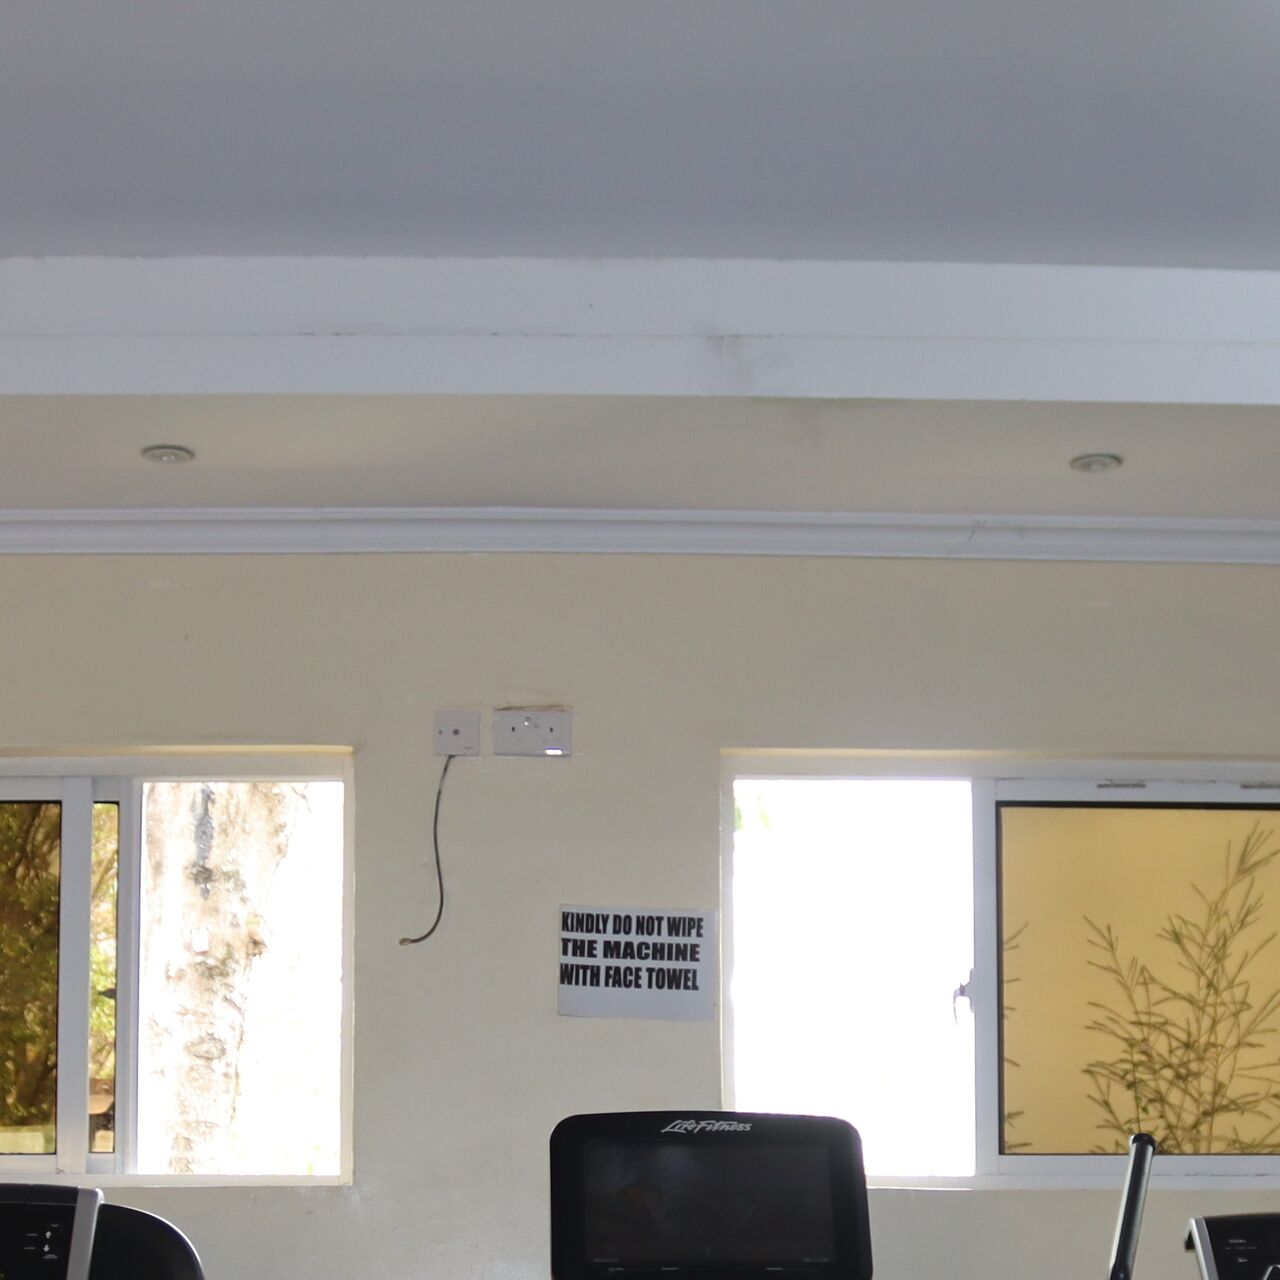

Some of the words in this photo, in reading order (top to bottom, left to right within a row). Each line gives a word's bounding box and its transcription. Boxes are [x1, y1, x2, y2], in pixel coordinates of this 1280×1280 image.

[561, 911, 610, 935] KINDLY
[612, 914, 632, 936] DO
[636, 915, 665, 936] NOT
[667, 916, 704, 938] WIPE
[561, 938, 598, 958] THE
[603, 940, 700, 962] MACHINE
[560, 963, 601, 987] WITH
[604, 965, 642, 989] FACE
[646, 967, 699, 991] TOWEL
